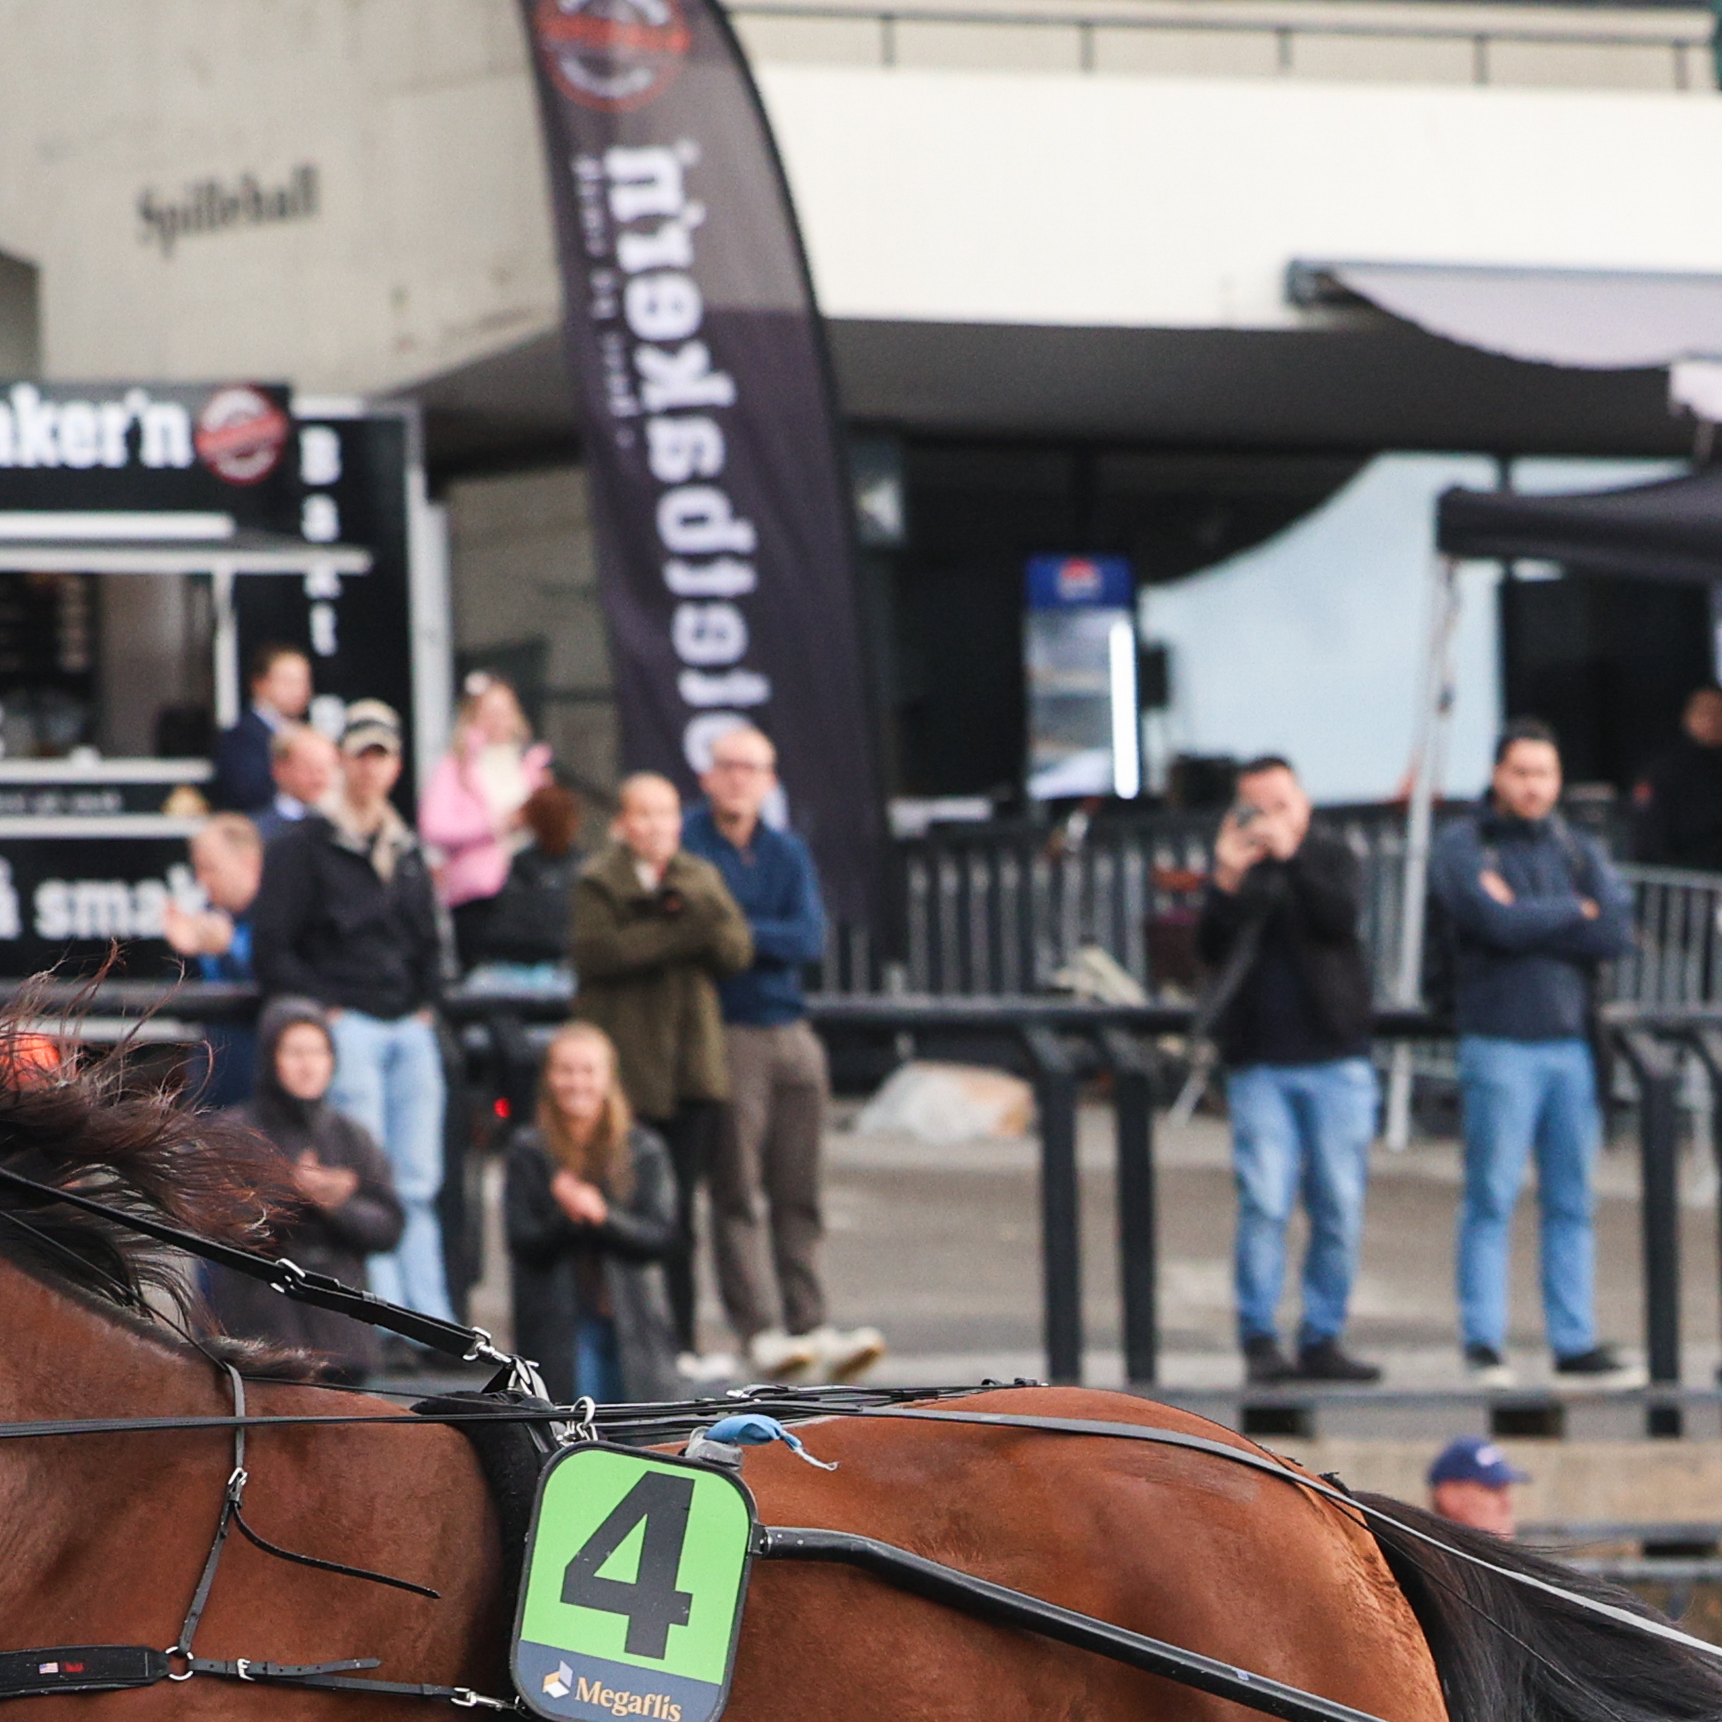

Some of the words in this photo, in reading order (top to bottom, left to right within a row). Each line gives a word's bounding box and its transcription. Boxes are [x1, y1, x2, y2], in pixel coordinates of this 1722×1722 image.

[135, 162, 321, 258] Spillehall
[560, 1470, 695, 1660] 4
[575, 1676, 682, 1722] Megaflis
